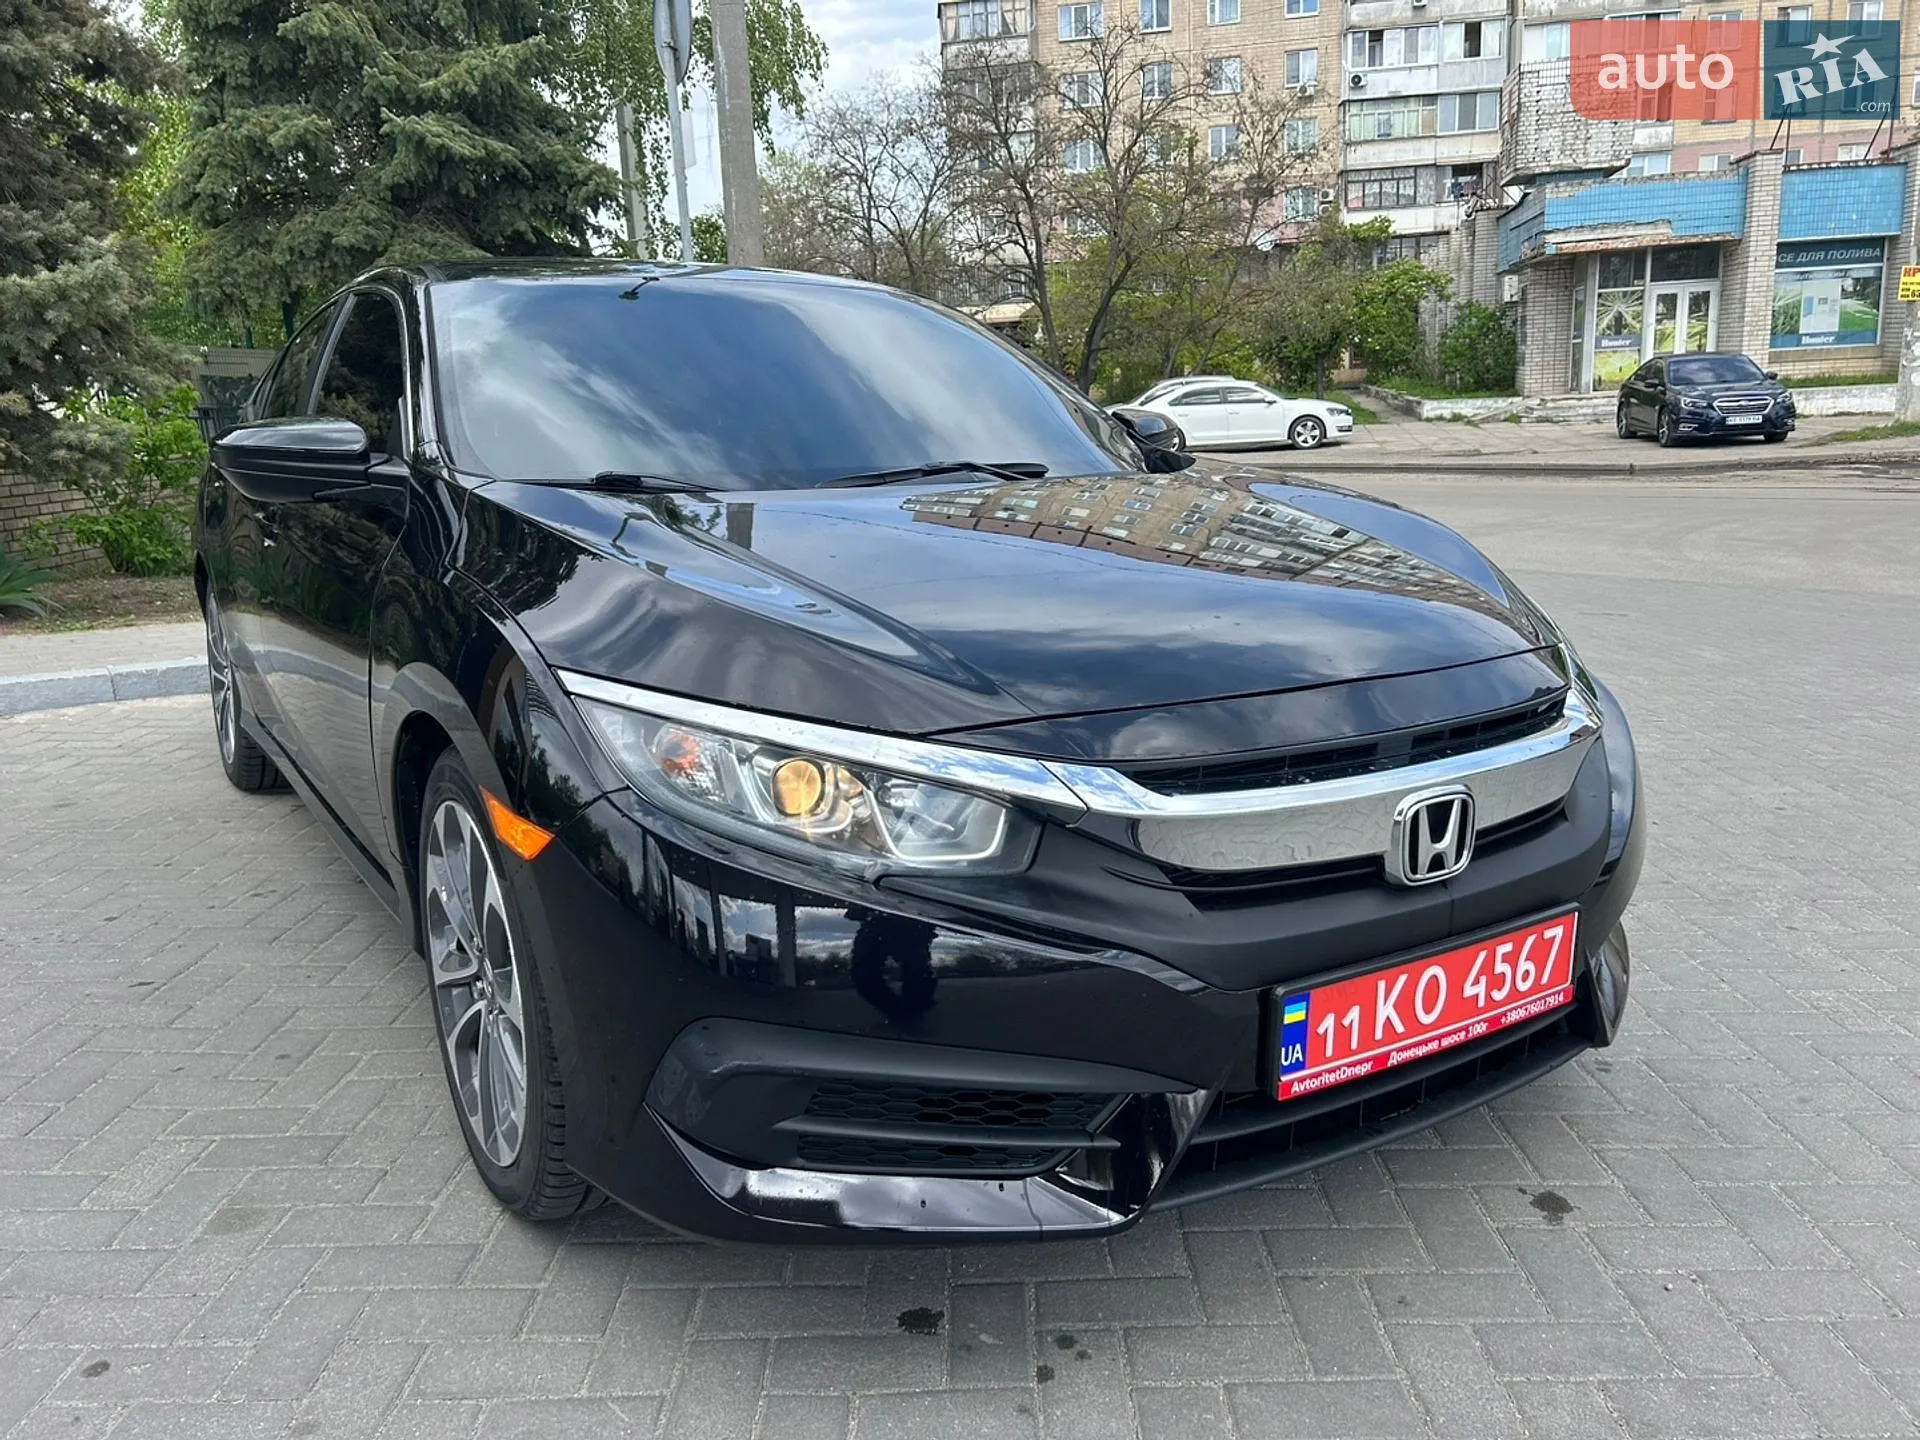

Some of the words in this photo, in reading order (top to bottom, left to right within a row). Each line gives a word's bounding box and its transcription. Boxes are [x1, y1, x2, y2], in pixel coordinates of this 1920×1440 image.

[1796, 250, 1825, 264] ДЛЯ
[1826, 247, 1881, 261] ПОЛИВА
[1463, 924, 1564, 1009] 4567
[1281, 1043, 1304, 1067] UA
[1387, 1039, 1440, 1068] Донецьке
[1440, 1030, 1467, 1047] шосе
[1291, 1060, 1375, 1095] AvtoritetDnepr
